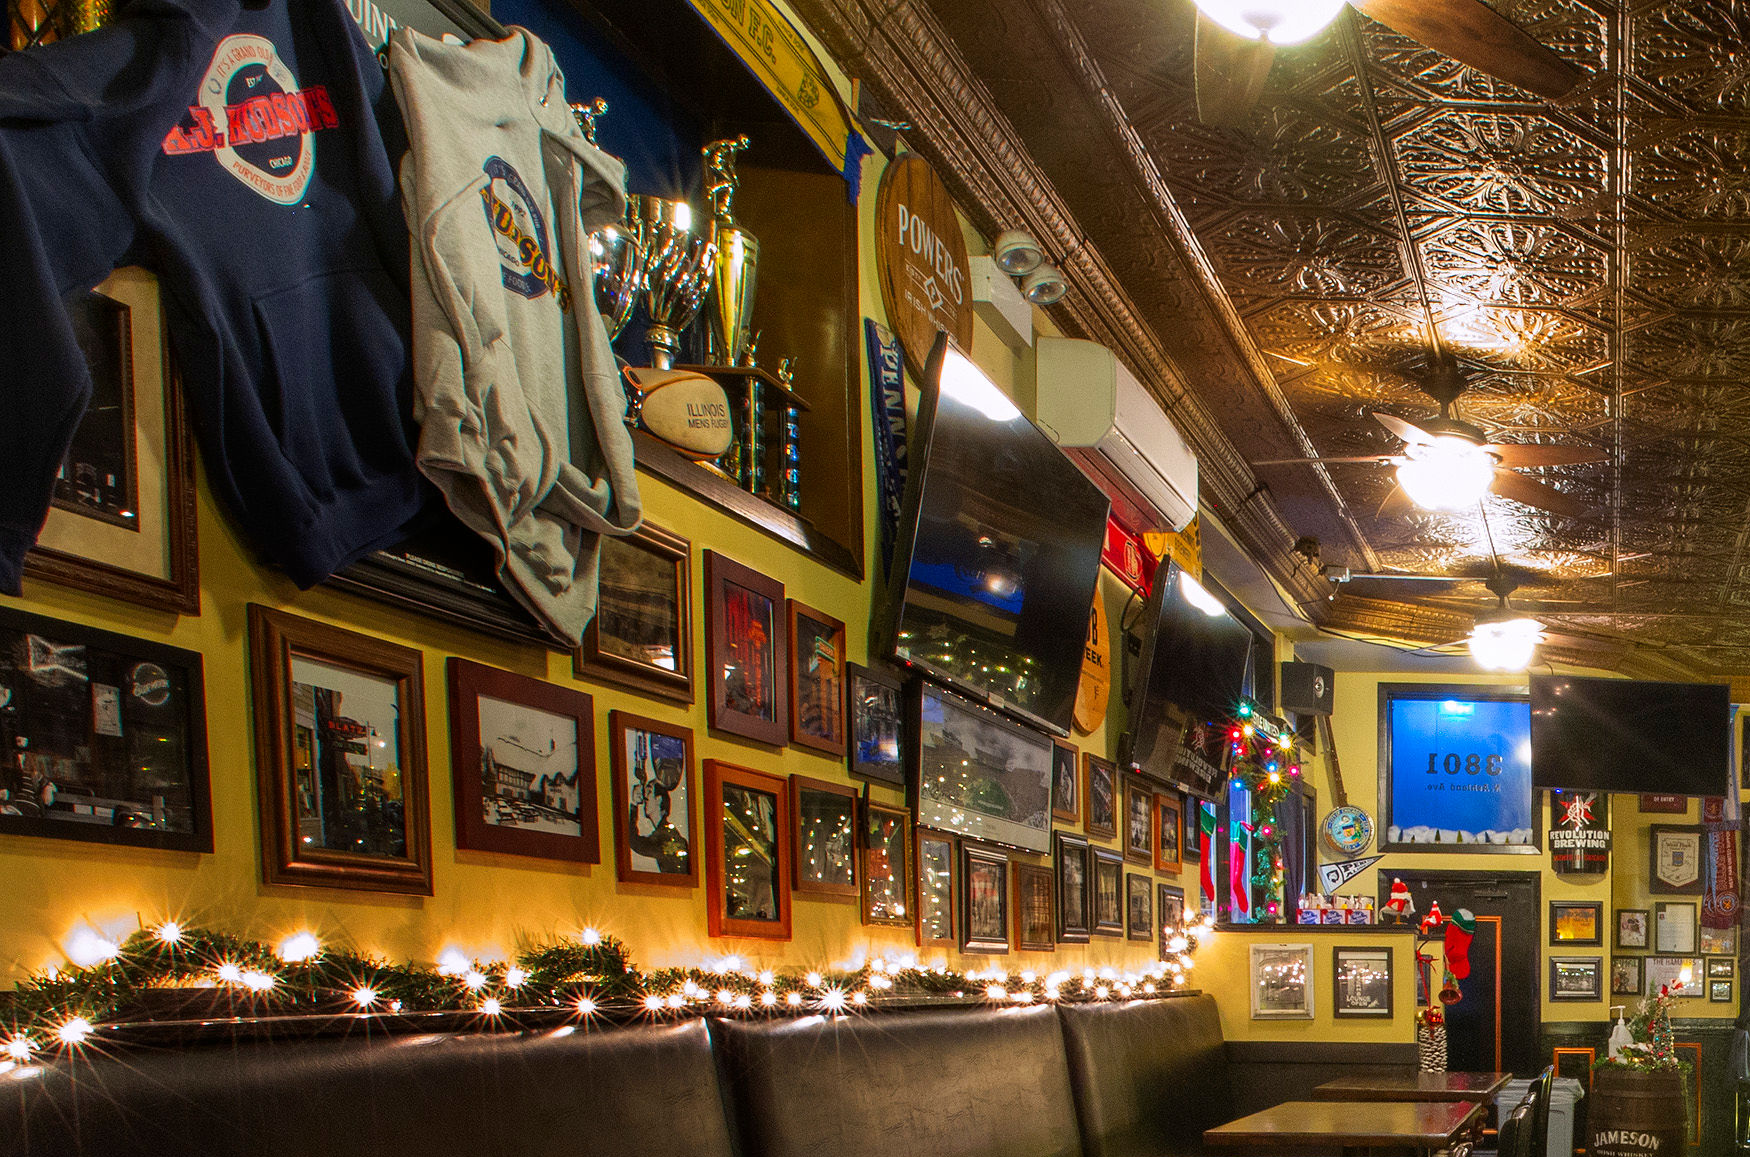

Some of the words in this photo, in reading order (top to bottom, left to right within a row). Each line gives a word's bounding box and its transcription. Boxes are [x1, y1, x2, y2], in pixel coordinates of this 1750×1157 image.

[233, 161, 275, 195] PURVEYORS
[898, 203, 962, 305] POWERS
[686, 403, 726, 417] ILLINOIS
[688, 419, 710, 429] MENS
[1550, 830, 1610, 841] REVOLUTION
[1554, 838, 1606, 849] BREWING
[1653, 959, 1665, 967] THE
[1593, 1130, 1660, 1150] JAMESON
